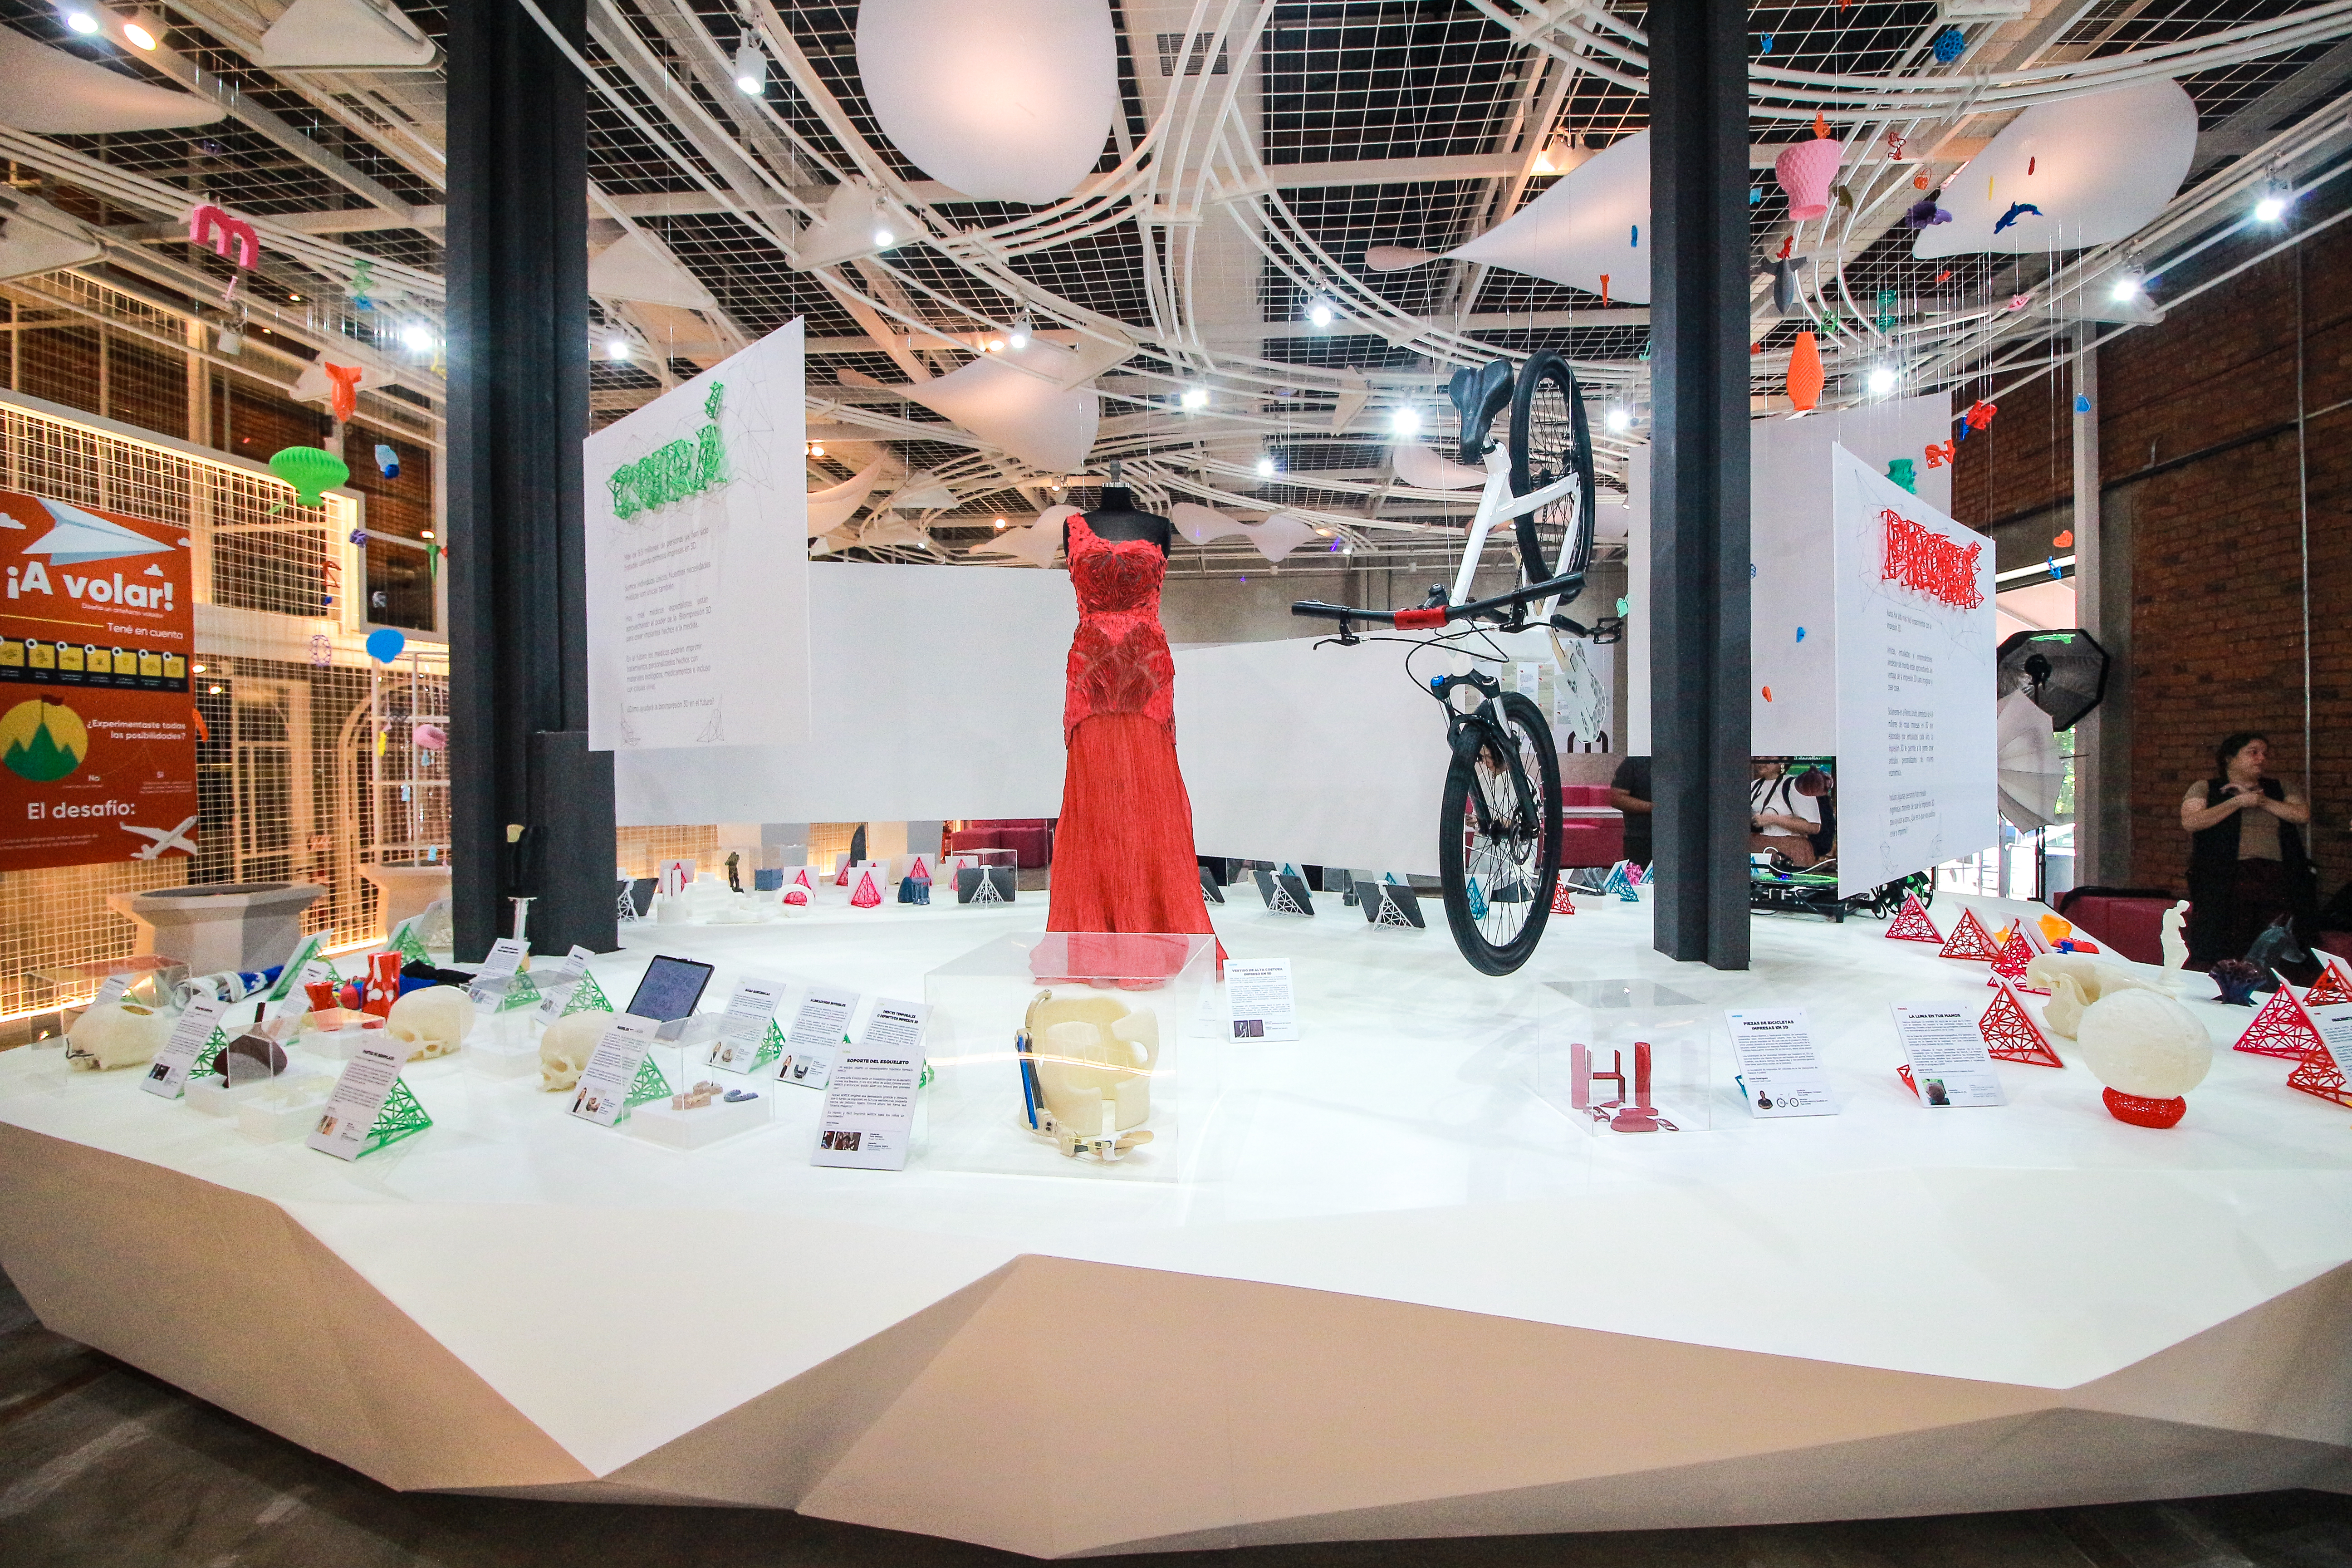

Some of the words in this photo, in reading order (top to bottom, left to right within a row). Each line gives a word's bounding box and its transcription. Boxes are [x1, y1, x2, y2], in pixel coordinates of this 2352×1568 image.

[7, 561, 53, 599] ¡A
[63, 573, 174, 611] volar!
[107, 622, 132, 634] Tené
[149, 629, 183, 640] cuenta
[88, 720, 160, 729] ¿Experimentaste
[126, 731, 186, 740] posibilidades?
[28, 802, 45, 819] El
